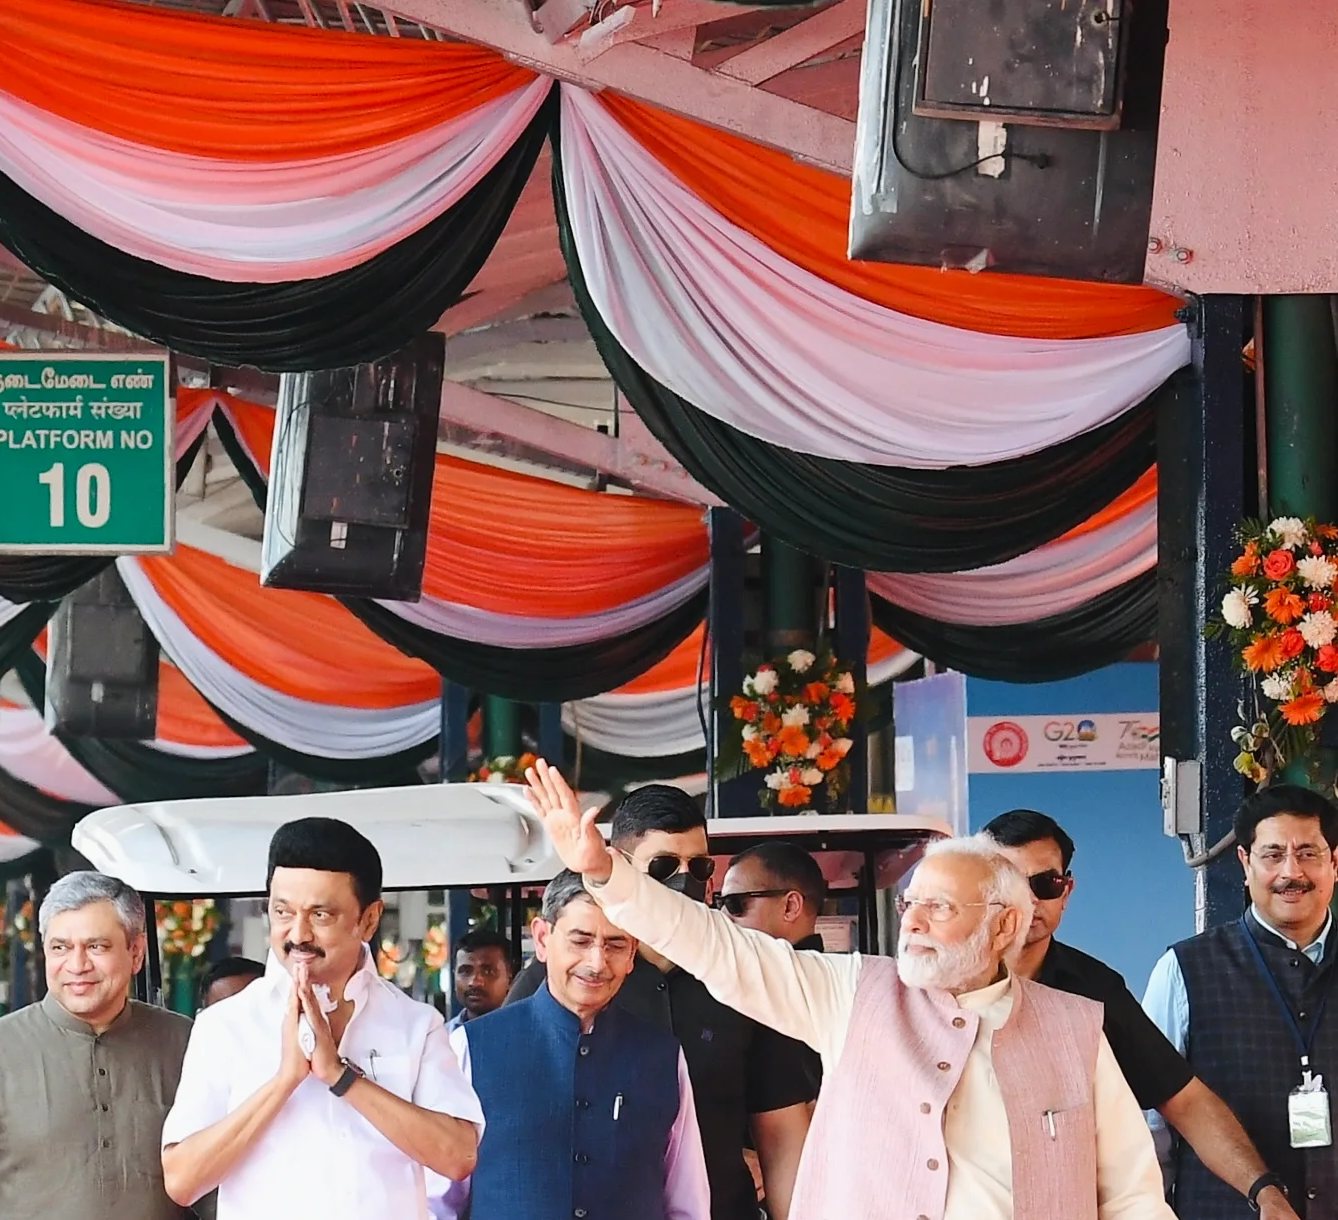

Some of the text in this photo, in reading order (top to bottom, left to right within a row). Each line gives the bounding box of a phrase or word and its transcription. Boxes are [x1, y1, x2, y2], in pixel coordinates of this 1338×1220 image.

[110, 369, 154, 390] எண்
[2, 395, 143, 419] प्लेटफार्म संख्या
[120, 429, 154, 449] NO
[38, 462, 112, 529] 10
